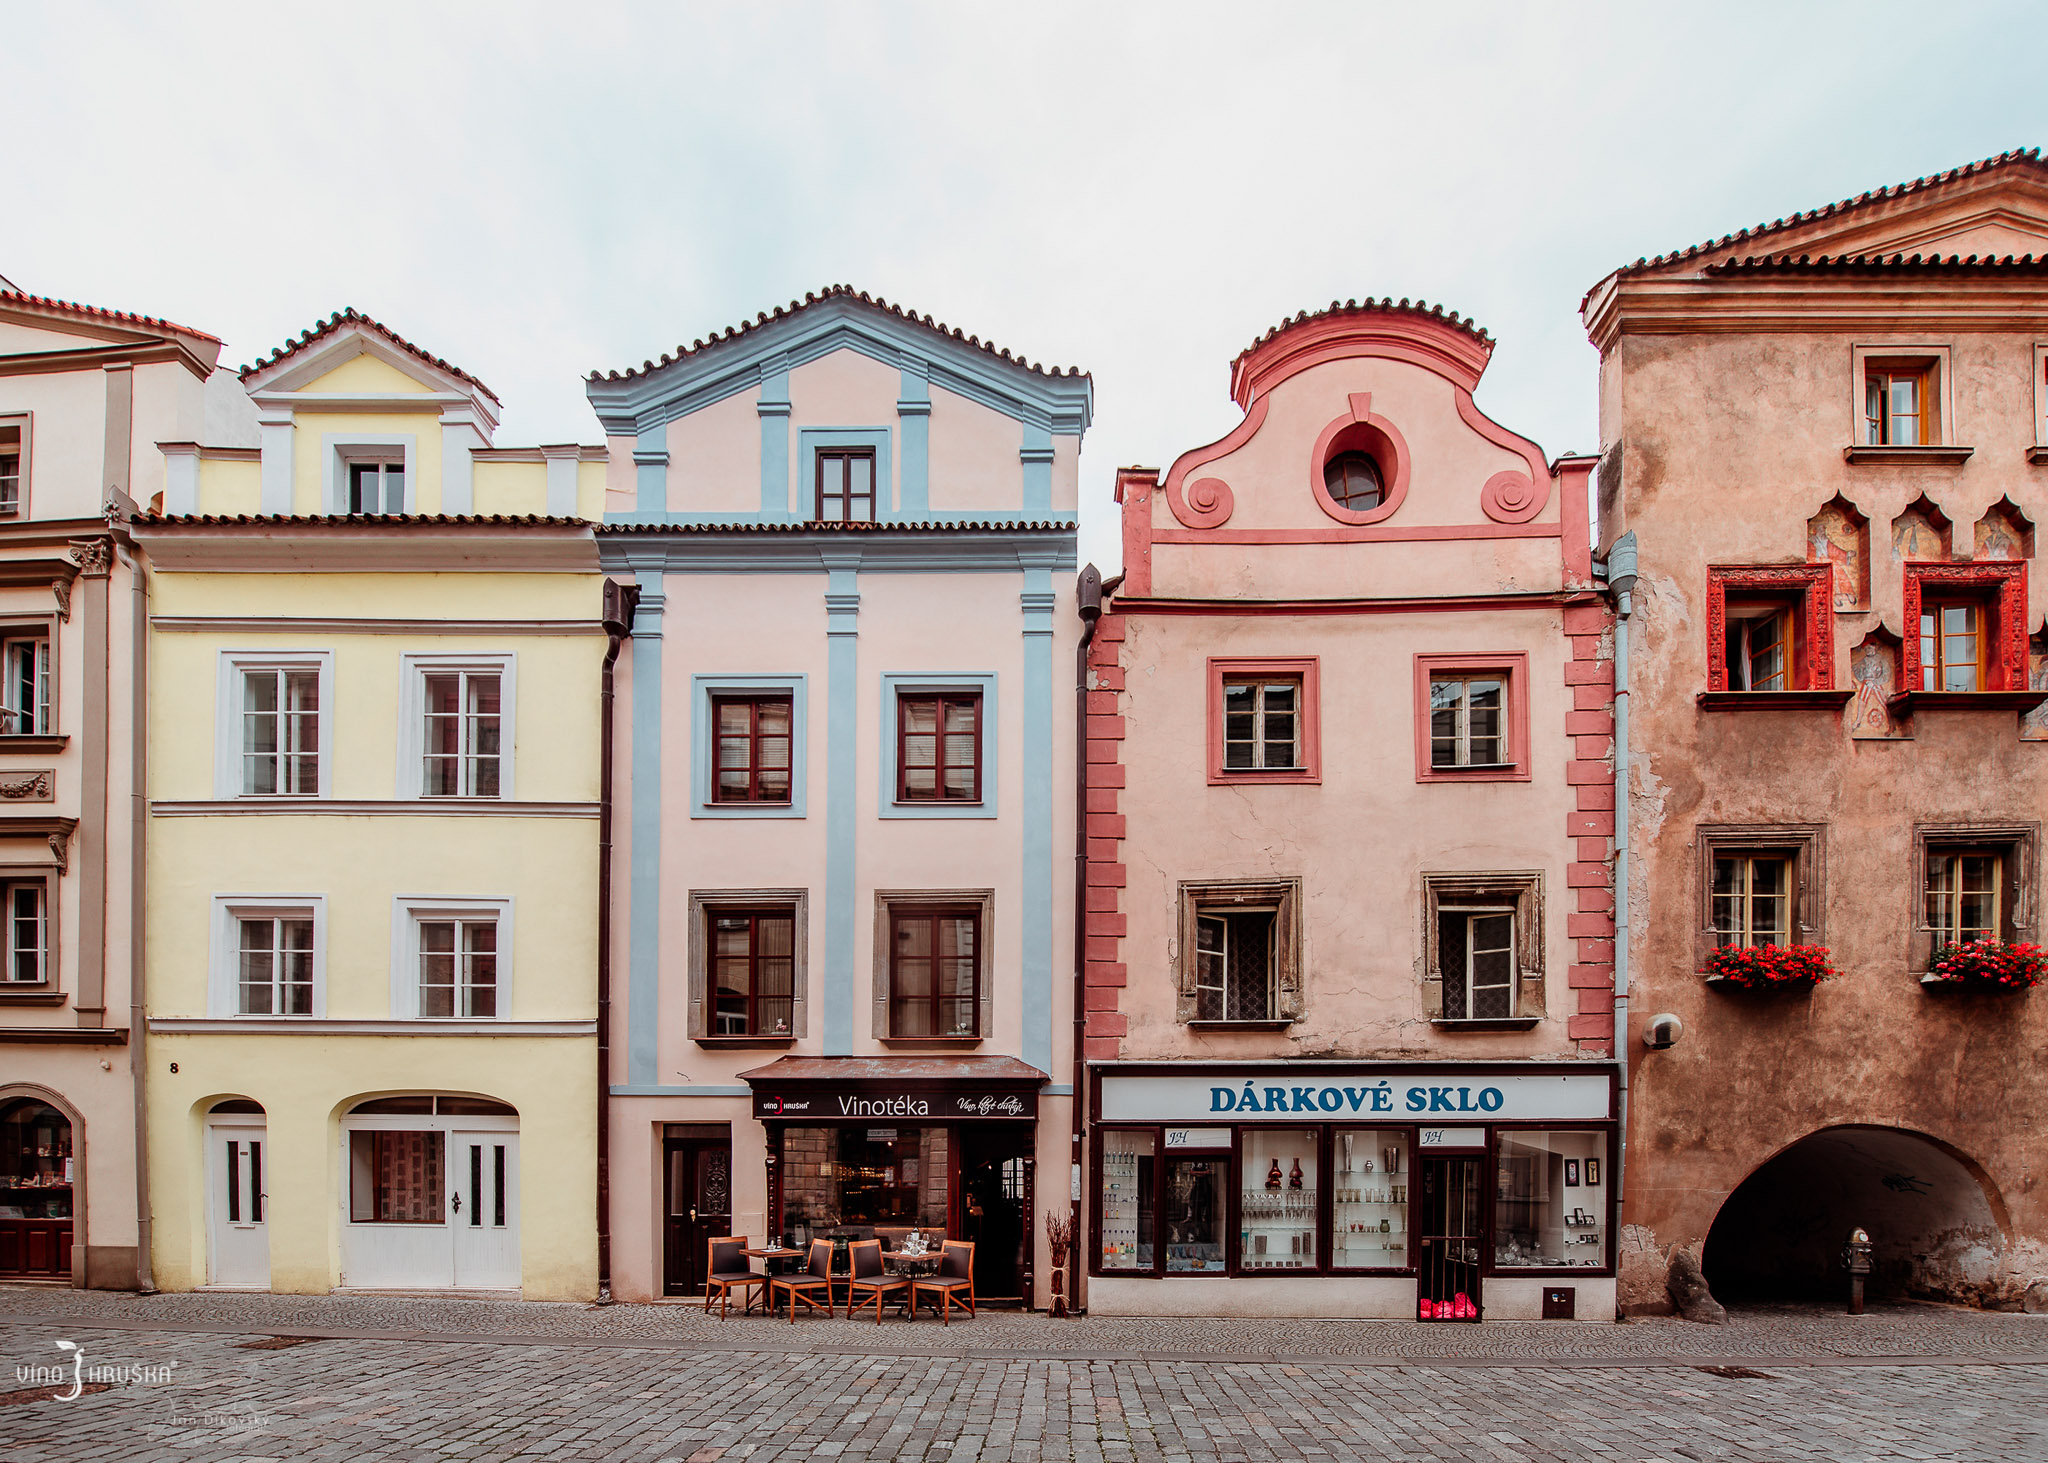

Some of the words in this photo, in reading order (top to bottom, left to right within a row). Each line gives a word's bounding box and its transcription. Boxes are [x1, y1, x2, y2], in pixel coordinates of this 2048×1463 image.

[170, 1062, 179, 1074] 8
[838, 1095, 929, 1116] Vinotéka
[1209, 1080, 1394, 1112] DÁRKOVÉ
[1405, 1087, 1504, 1112] SKLO
